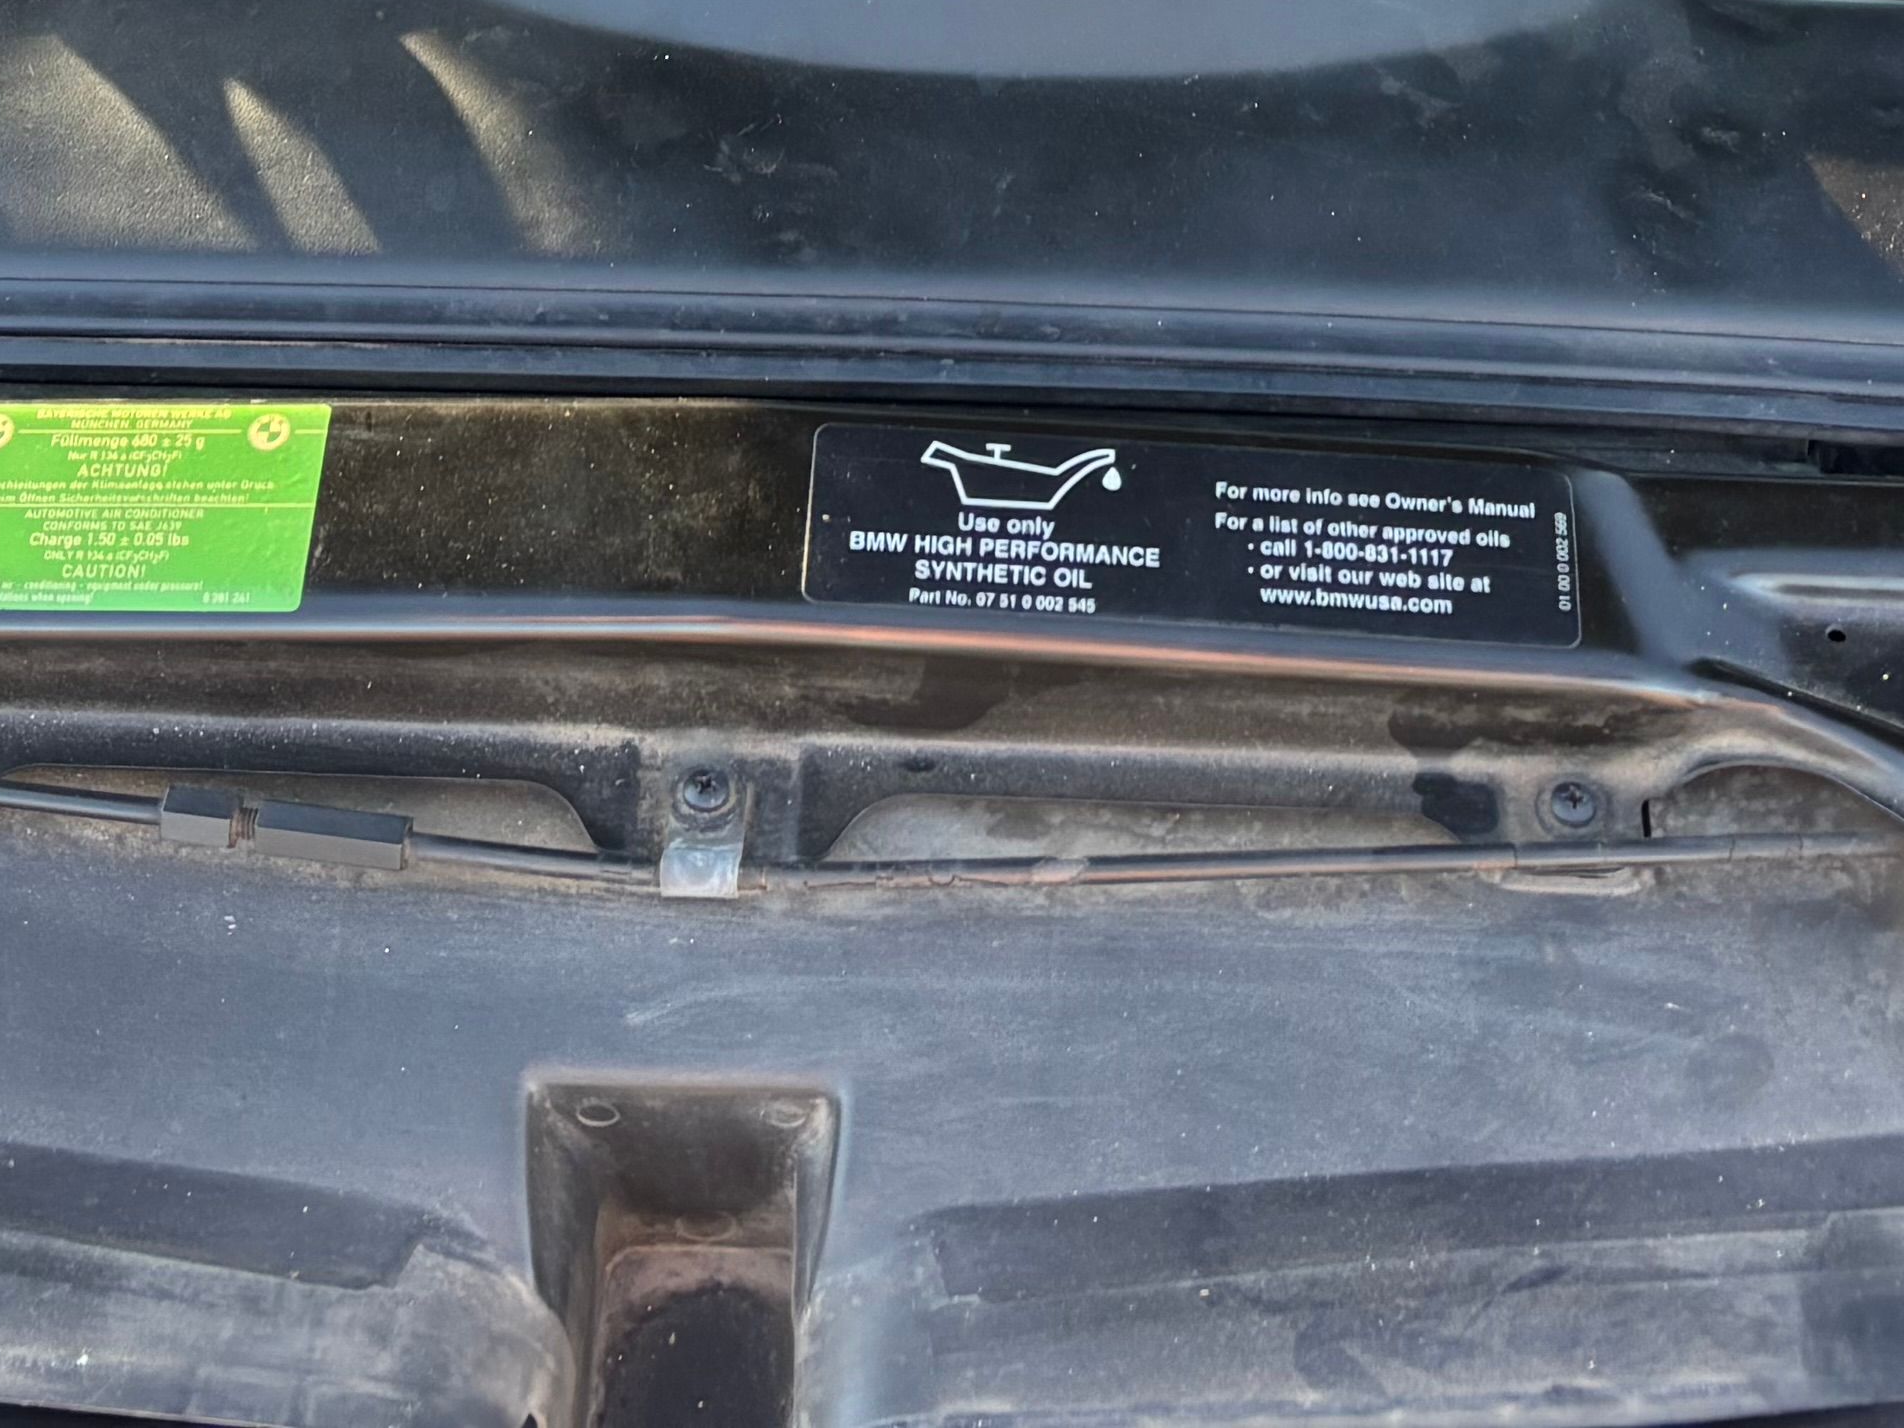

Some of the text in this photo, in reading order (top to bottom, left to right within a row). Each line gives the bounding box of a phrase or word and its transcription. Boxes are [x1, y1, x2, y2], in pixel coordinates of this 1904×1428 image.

[36, 408, 232, 420] BAYERISCHE MOTOREN WERKE AG
[135, 419, 194, 430] GERMANY
[51, 432, 128, 451] Füllmenge
[131, 434, 158, 447] 680
[174, 434, 194, 447] 25
[196, 436, 205, 451] g
[77, 462, 169, 478] ACHTUNG!
[70, 479, 88, 490] der
[166, 480, 205, 490] stehen
[207, 480, 238, 491] unter
[19, 492, 57, 503] Öffnen
[1215, 481, 1536, 519] For more info see Owner's Manual
[24, 508, 204, 519] AUTOMOTIVE AIR CONDITIONER
[42, 520, 108, 531] CONFORMS
[110, 520, 126, 531] TO
[128, 521, 153, 531] SAE
[958, 512, 1055, 540] Use only
[1215, 512, 1511, 548] For a list of other approved oils
[29, 532, 82, 549] Charge
[86, 532, 116, 546] 1.50
[133, 532, 164, 546] 0.05
[167, 532, 190, 546] lbs
[849, 531, 1161, 568] BMW HIGH PERFORMANCE
[43, 550, 75, 561] ONLY
[1260, 540, 1454, 567] call 1-800-831-1117
[62, 563, 146, 579] CAUTION!
[914, 559, 1093, 589] SYNTHETIC OIL
[1259, 563, 1491, 594] or visit our web site at
[908, 587, 940, 605] Part
[975, 591, 995, 608] 07
[999, 593, 1017, 608] 51
[1021, 594, 1032, 609] 0
[1035, 595, 1064, 611] 002
[1067, 597, 1096, 613] 545
[1259, 586, 1454, 614] www.bmwusa.com
